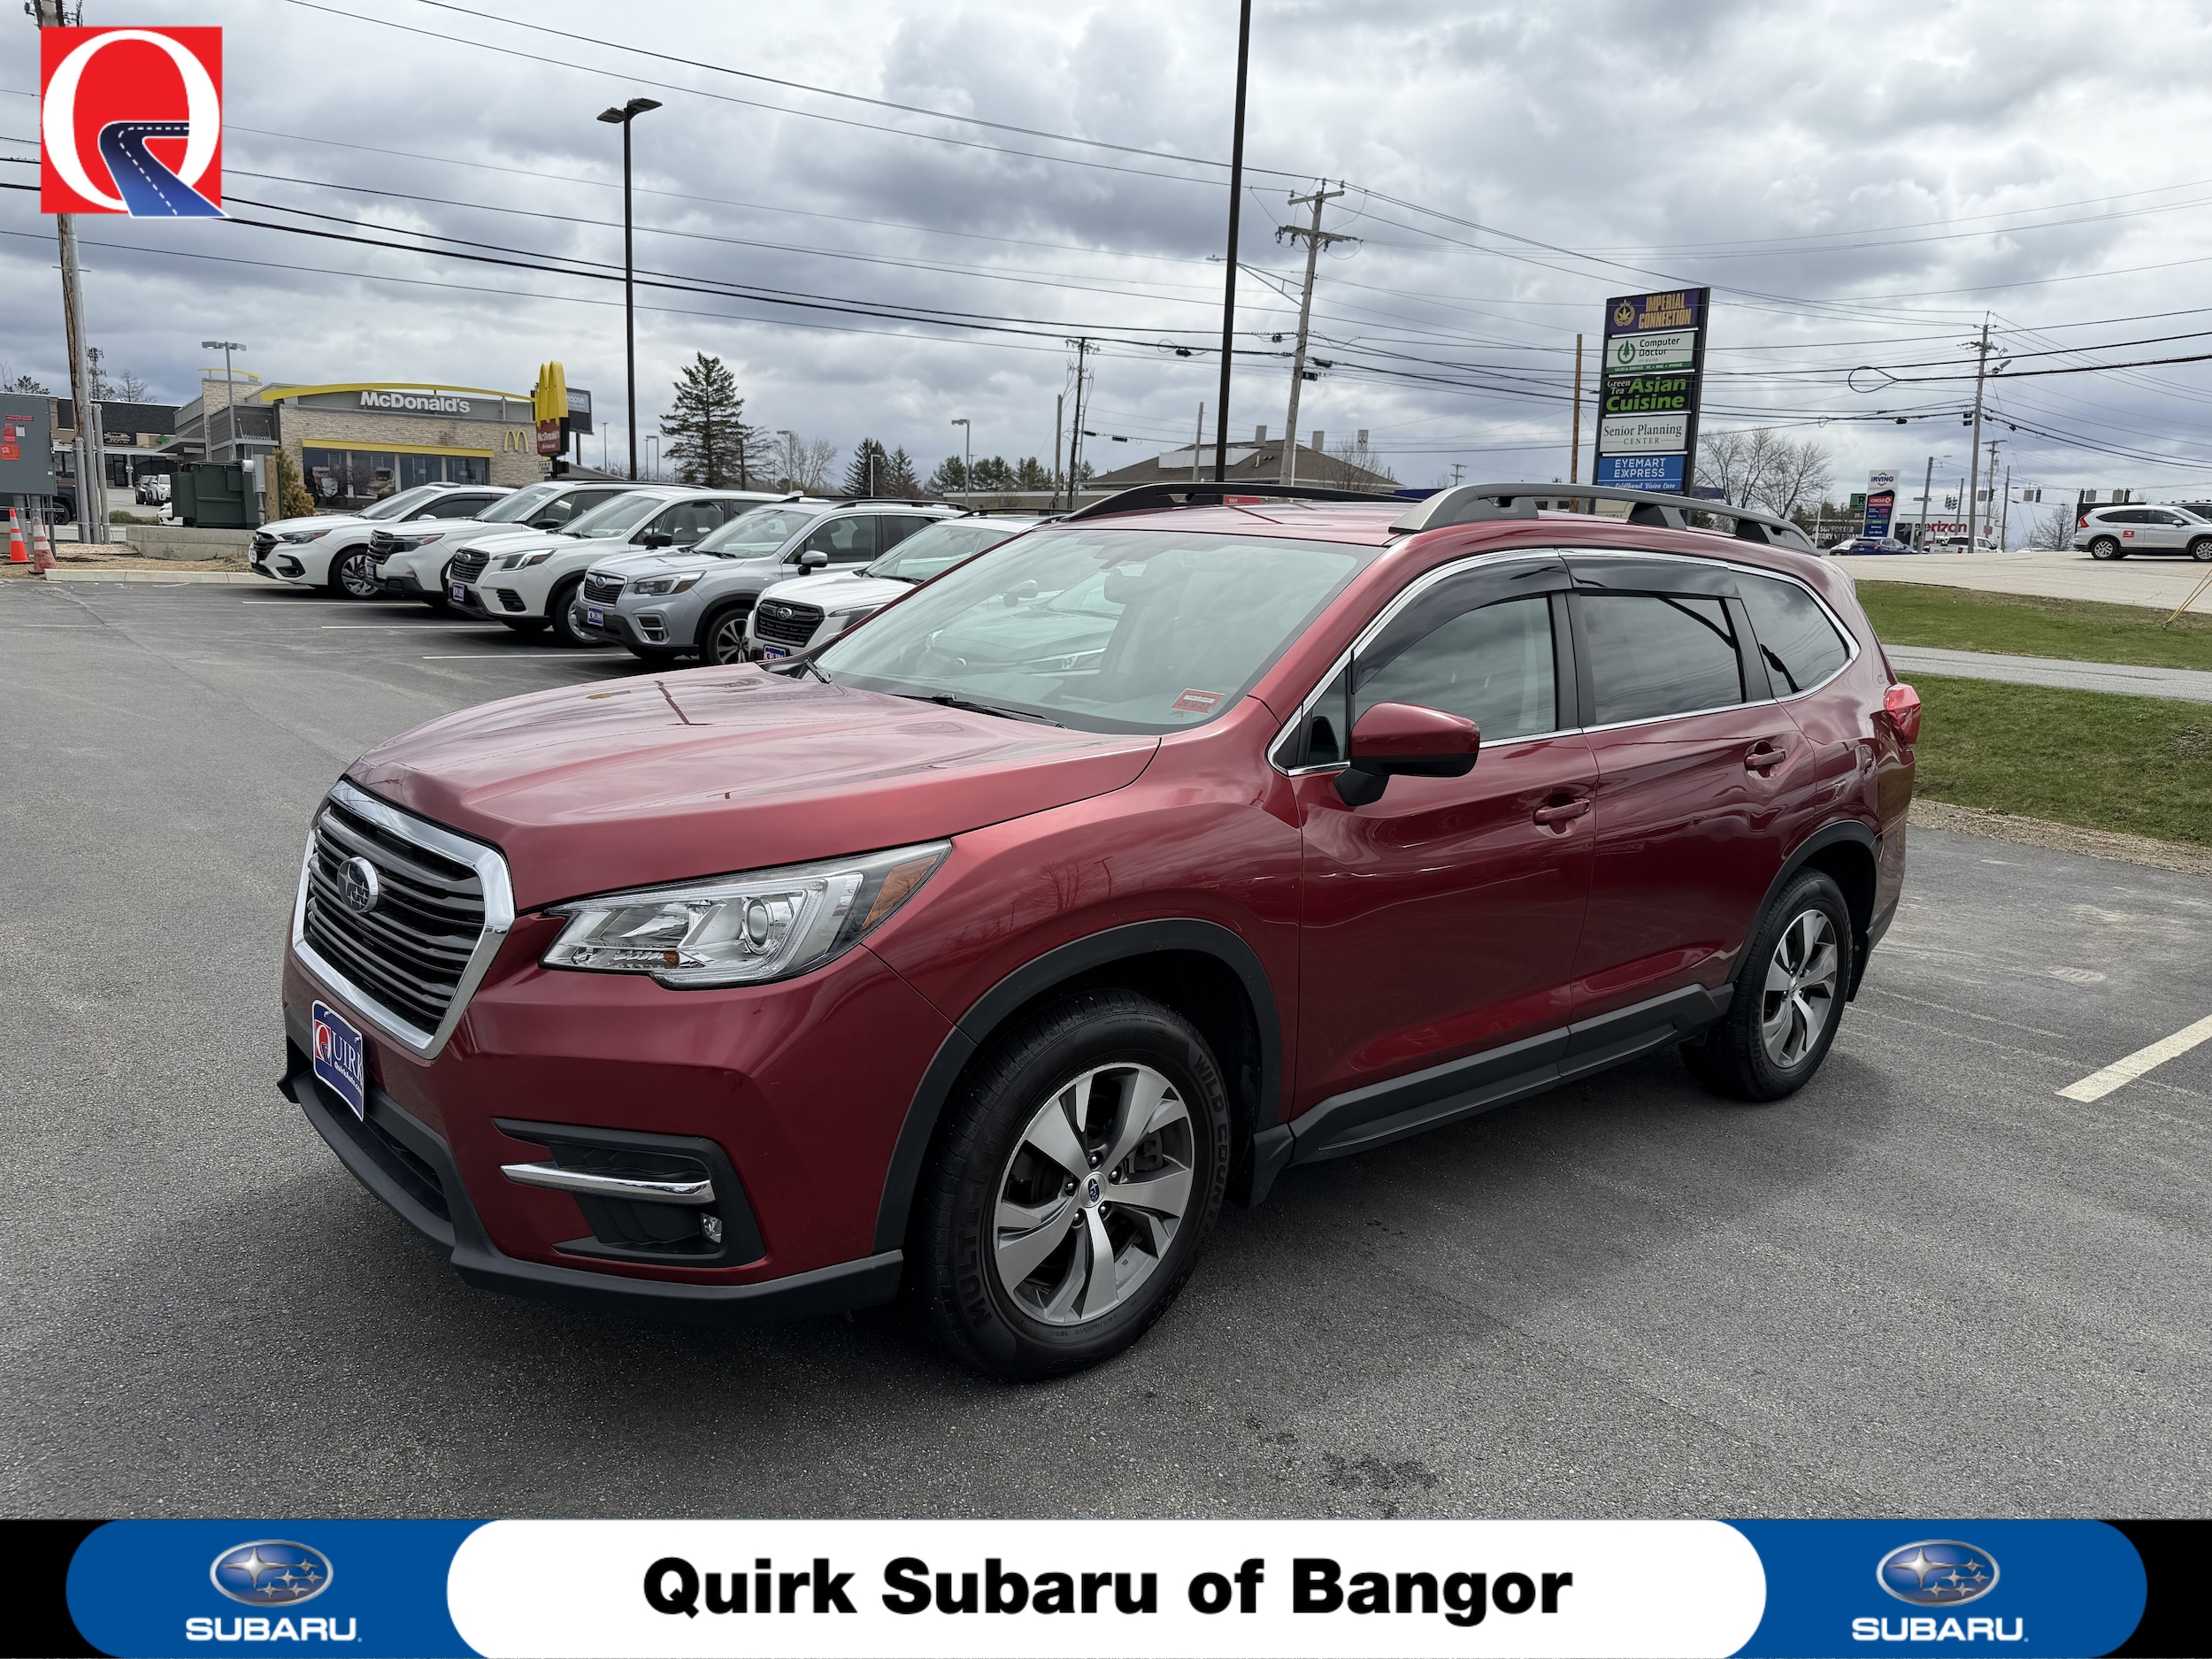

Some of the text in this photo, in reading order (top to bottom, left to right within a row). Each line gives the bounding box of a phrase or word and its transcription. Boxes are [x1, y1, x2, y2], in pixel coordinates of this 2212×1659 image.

[1646, 293, 1685, 312] IMPERIAL
[1638, 309, 1692, 329] CONNECTION
[1640, 338, 1680, 348] Computer
[1610, 387, 1624, 396] Tea
[1627, 376, 1686, 394] Asian
[360, 390, 471, 413] McDonald's
[1606, 394, 1685, 411] Cuisine
[537, 430, 560, 442] McDonald's
[1603, 424, 1683, 438] Senior Planning
[1615, 457, 1666, 468] EYEMART
[1614, 468, 1665, 479] EXPRESS
[1925, 520, 1967, 533] erizon
[315, 1023, 363, 1086] QUIRK
[1194, 1054, 1225, 1113] WILD
